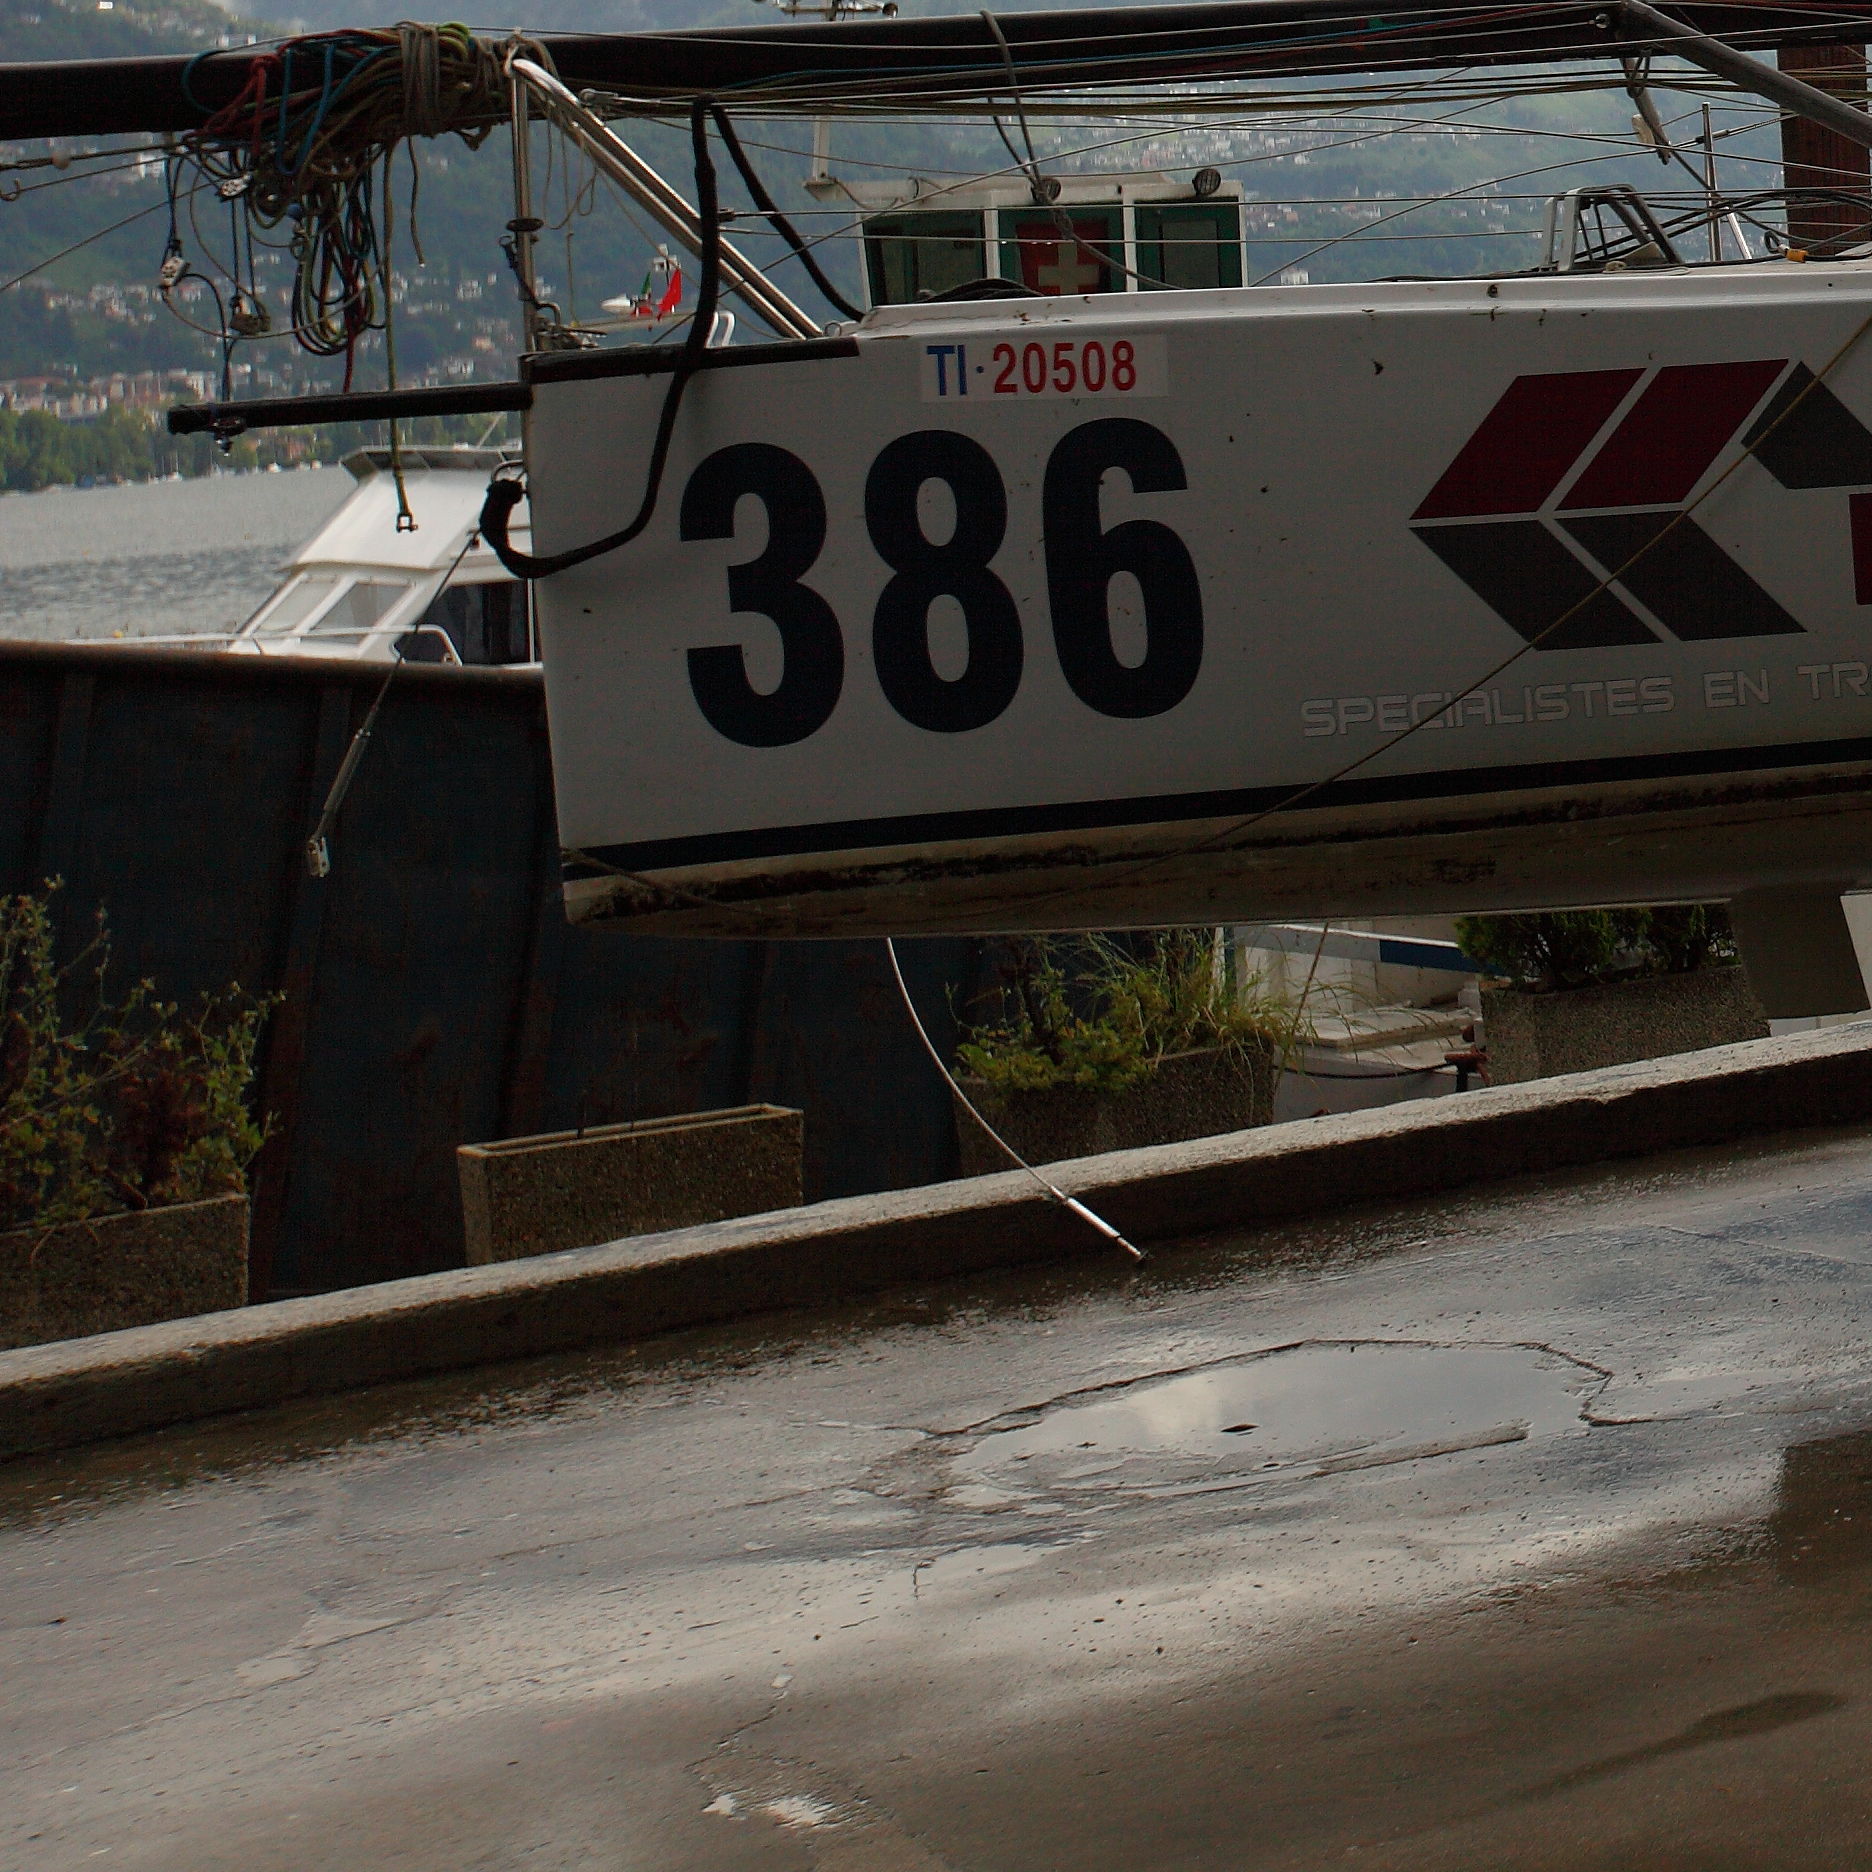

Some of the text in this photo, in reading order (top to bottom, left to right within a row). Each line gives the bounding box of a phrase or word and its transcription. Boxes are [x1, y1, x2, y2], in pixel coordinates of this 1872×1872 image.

[679, 417, 1204, 749] 386
[1300, 675, 1677, 738] SPECIALISTES
[1704, 667, 1770, 709] EN
